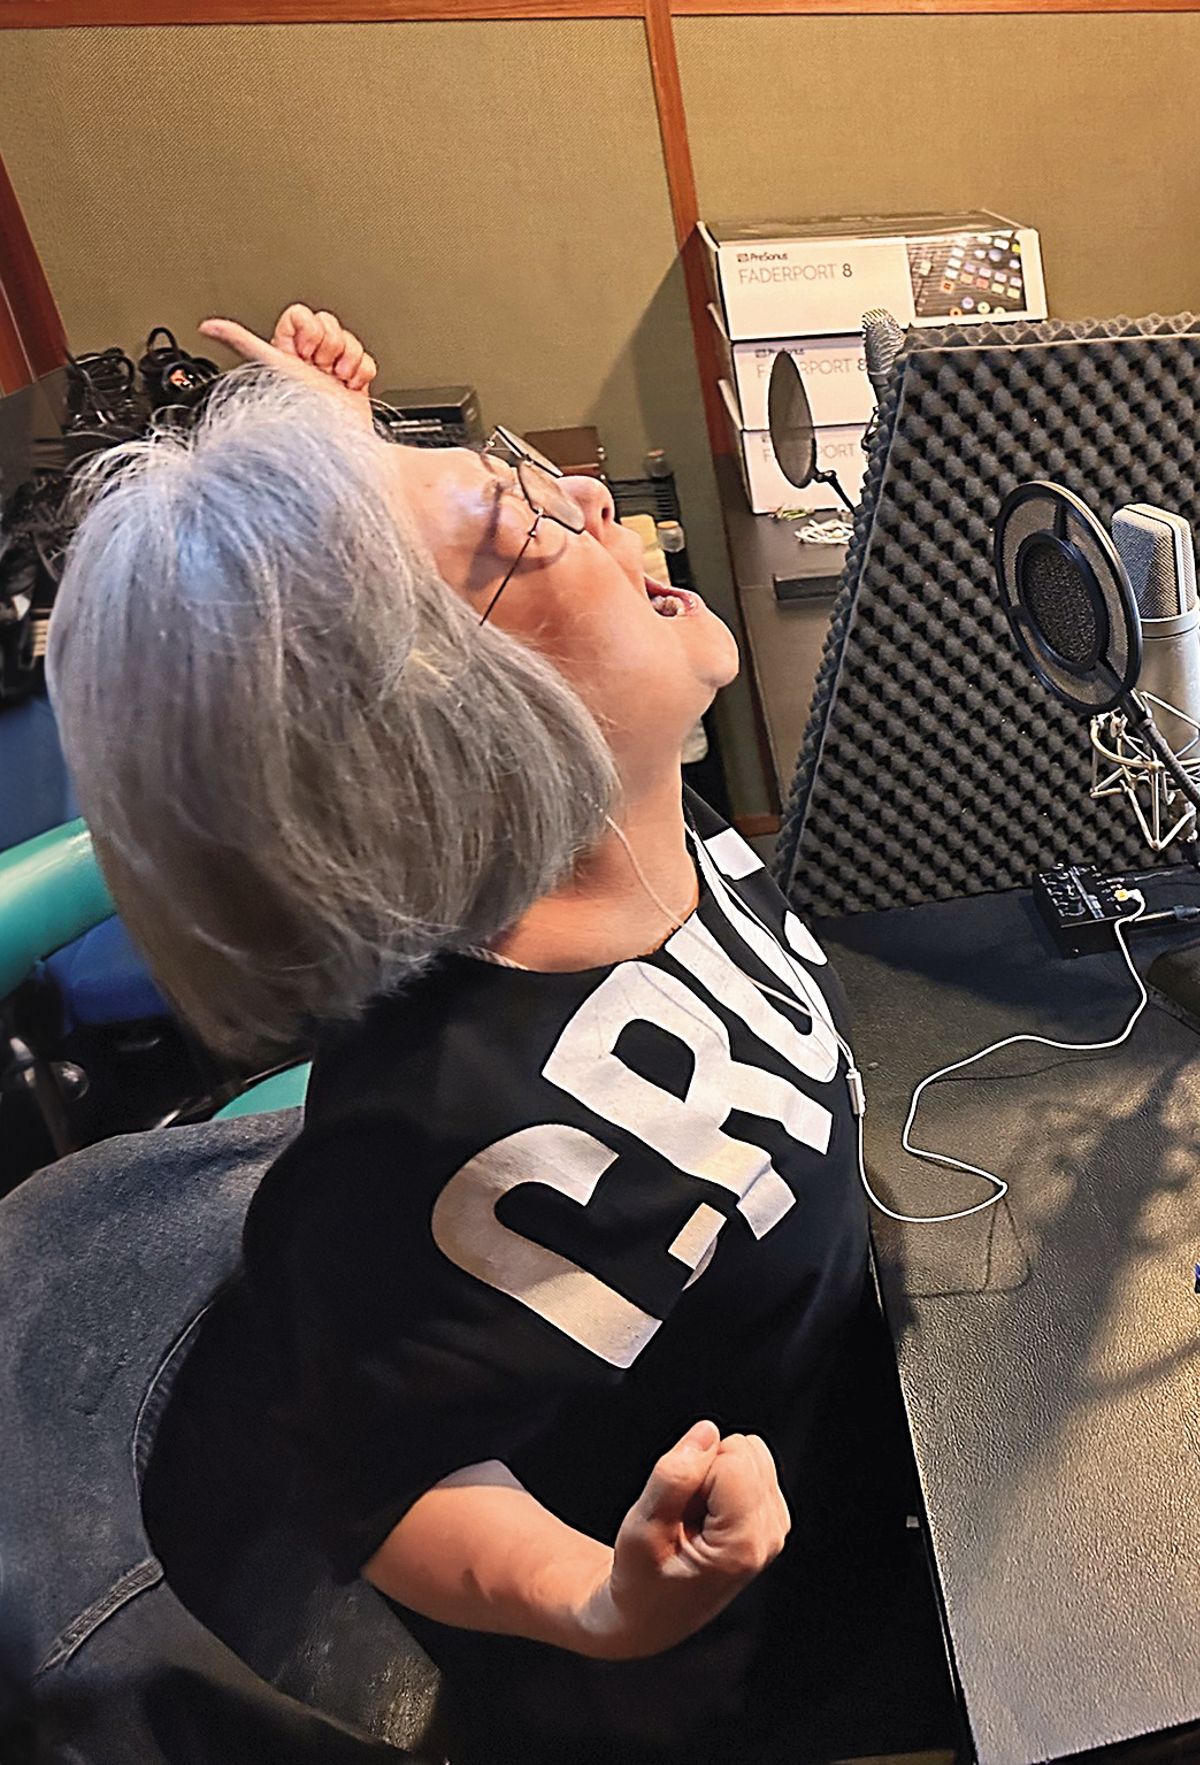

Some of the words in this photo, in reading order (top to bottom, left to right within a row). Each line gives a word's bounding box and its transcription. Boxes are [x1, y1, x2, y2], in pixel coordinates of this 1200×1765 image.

[750, 252, 788, 261] PreSonus
[739, 263, 836, 283] FADERPORT
[842, 263, 852, 277] 8
